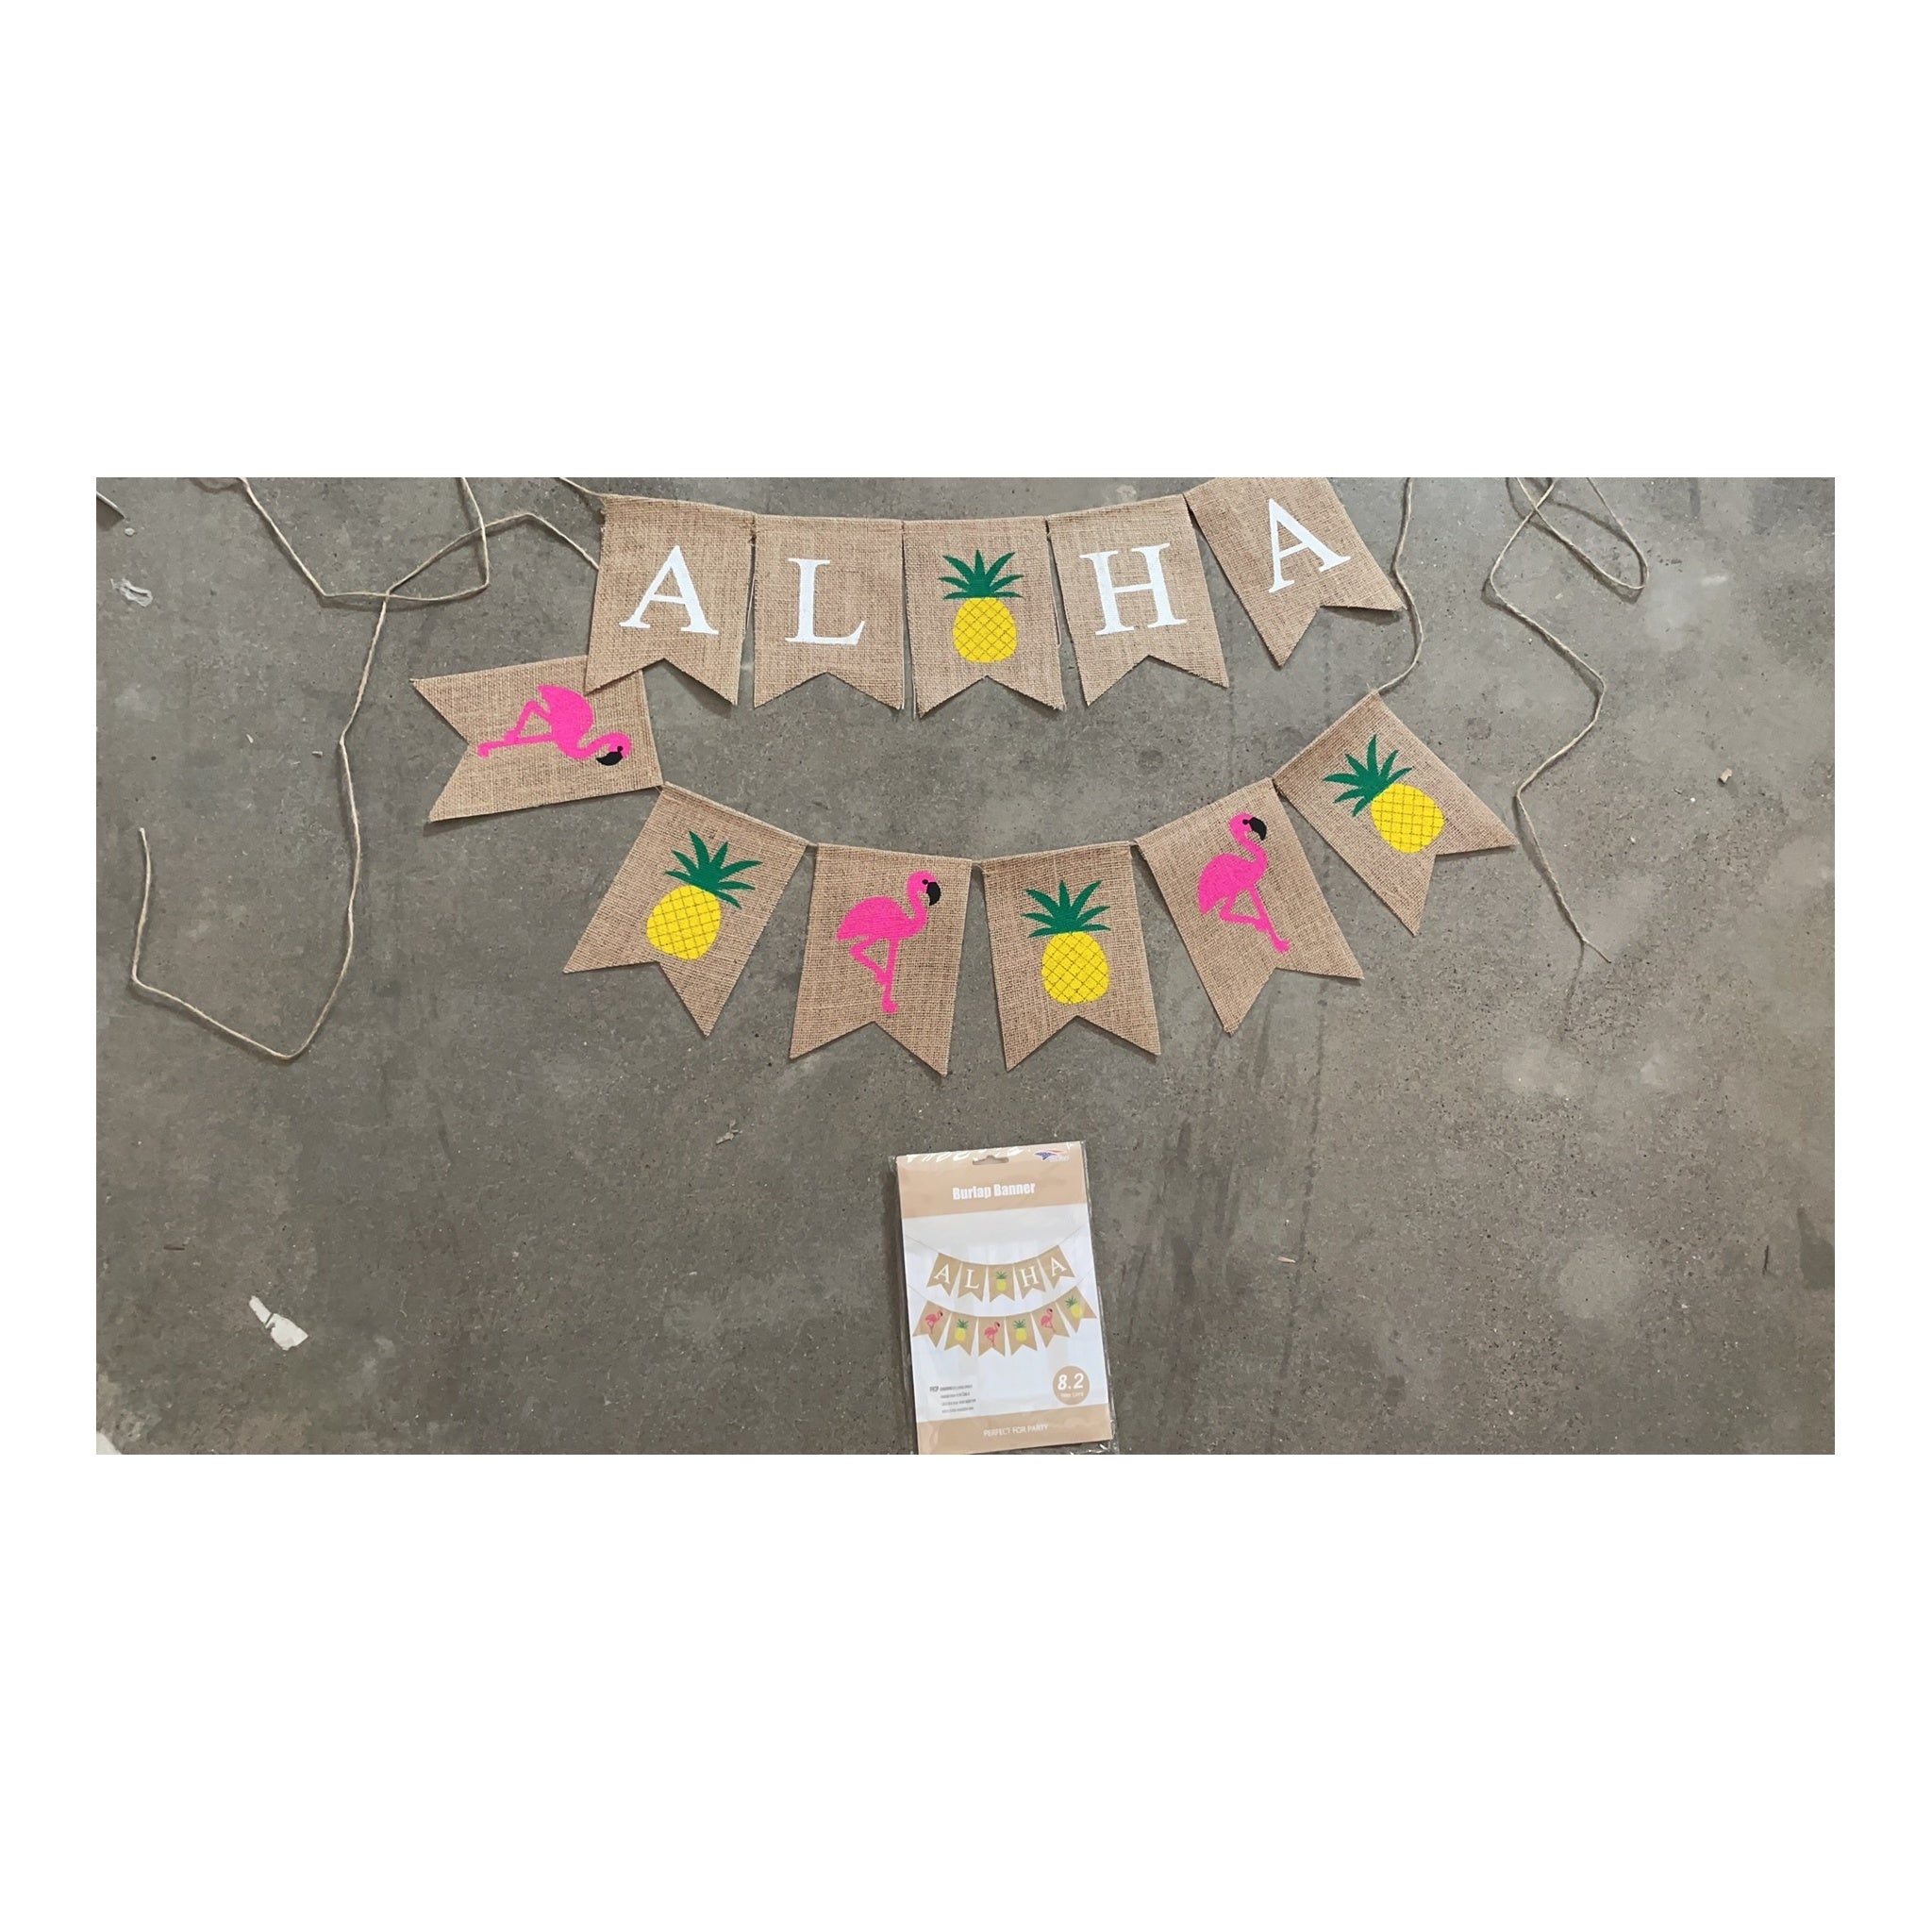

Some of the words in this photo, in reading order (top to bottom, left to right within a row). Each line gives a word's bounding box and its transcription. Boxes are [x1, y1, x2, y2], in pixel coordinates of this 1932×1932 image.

[953, 1185, 991, 1201] Burlap
[993, 1182, 1036, 1197] Banner
[1058, 1373, 1084, 1391] 8.2
[983, 1427, 1011, 1438] PERFECT
[1012, 1425, 1026, 1435] FOR
[1027, 1424, 1049, 1433] PARTY
